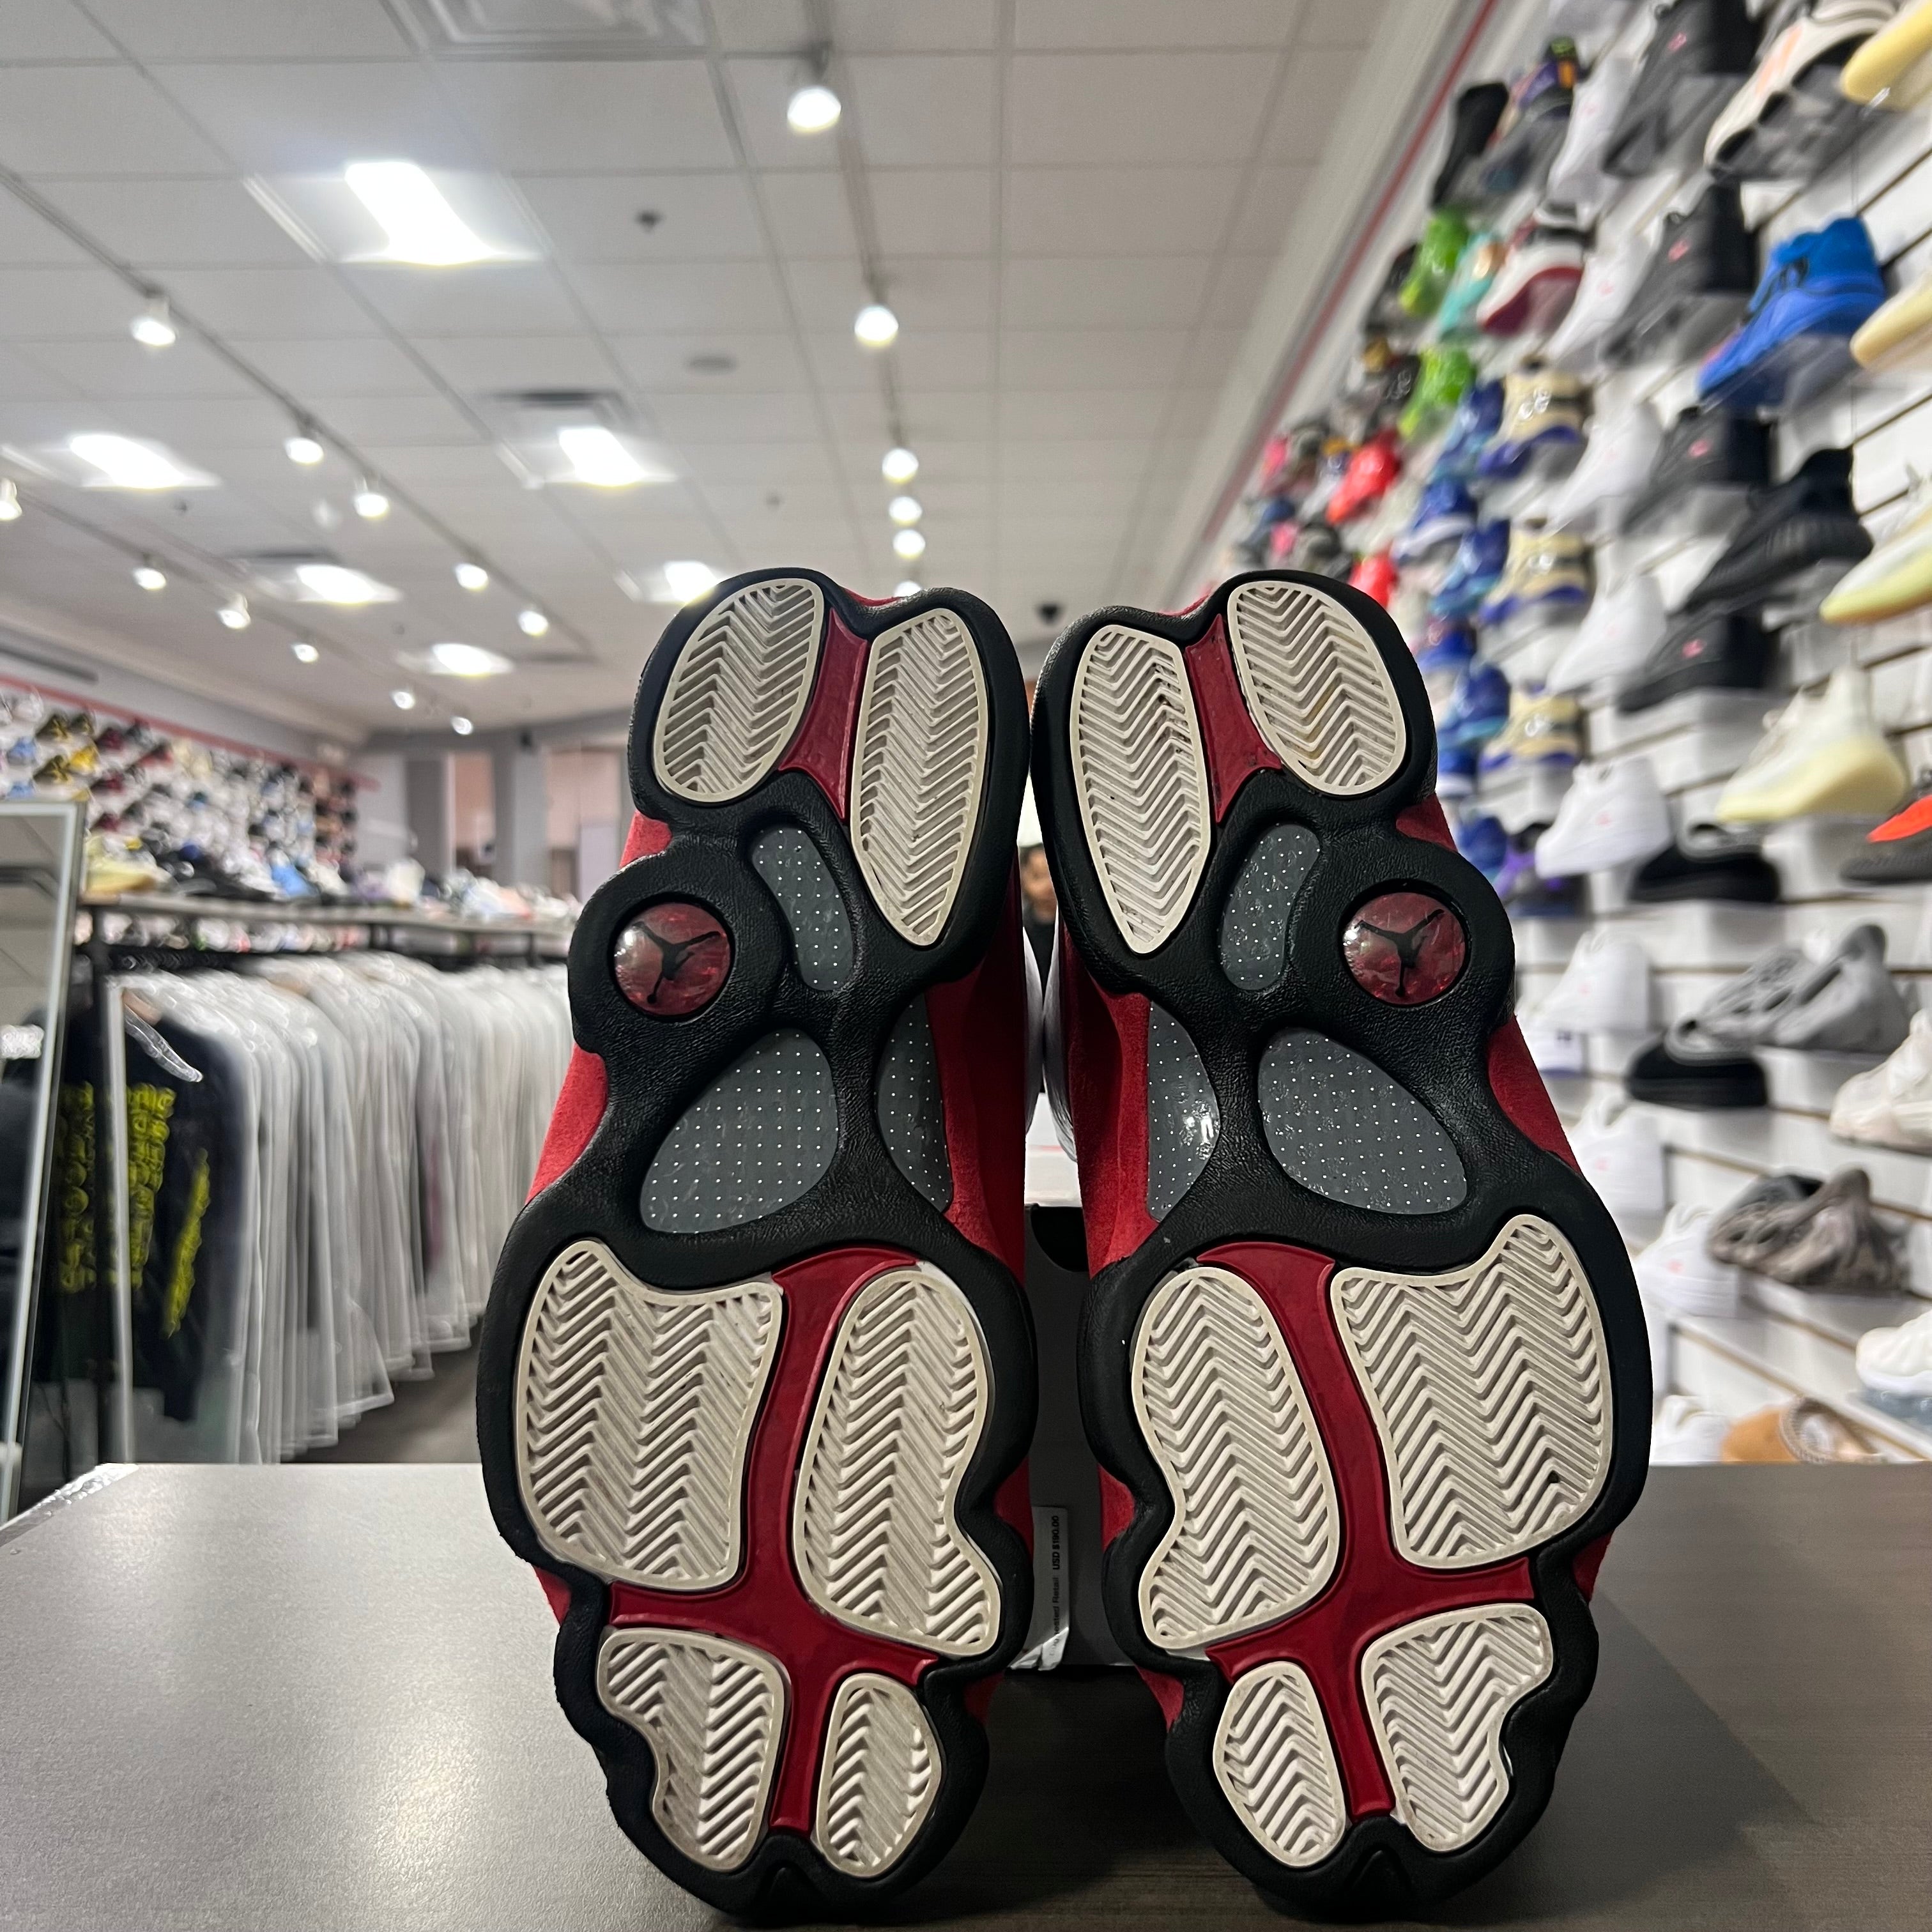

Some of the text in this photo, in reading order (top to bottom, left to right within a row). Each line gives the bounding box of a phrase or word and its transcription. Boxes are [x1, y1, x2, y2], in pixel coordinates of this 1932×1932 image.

[1051, 1515, 1061, 1549] $190.00
[1051, 1552, 1061, 1570] USD
[1051, 1577, 1060, 1604] Retail
